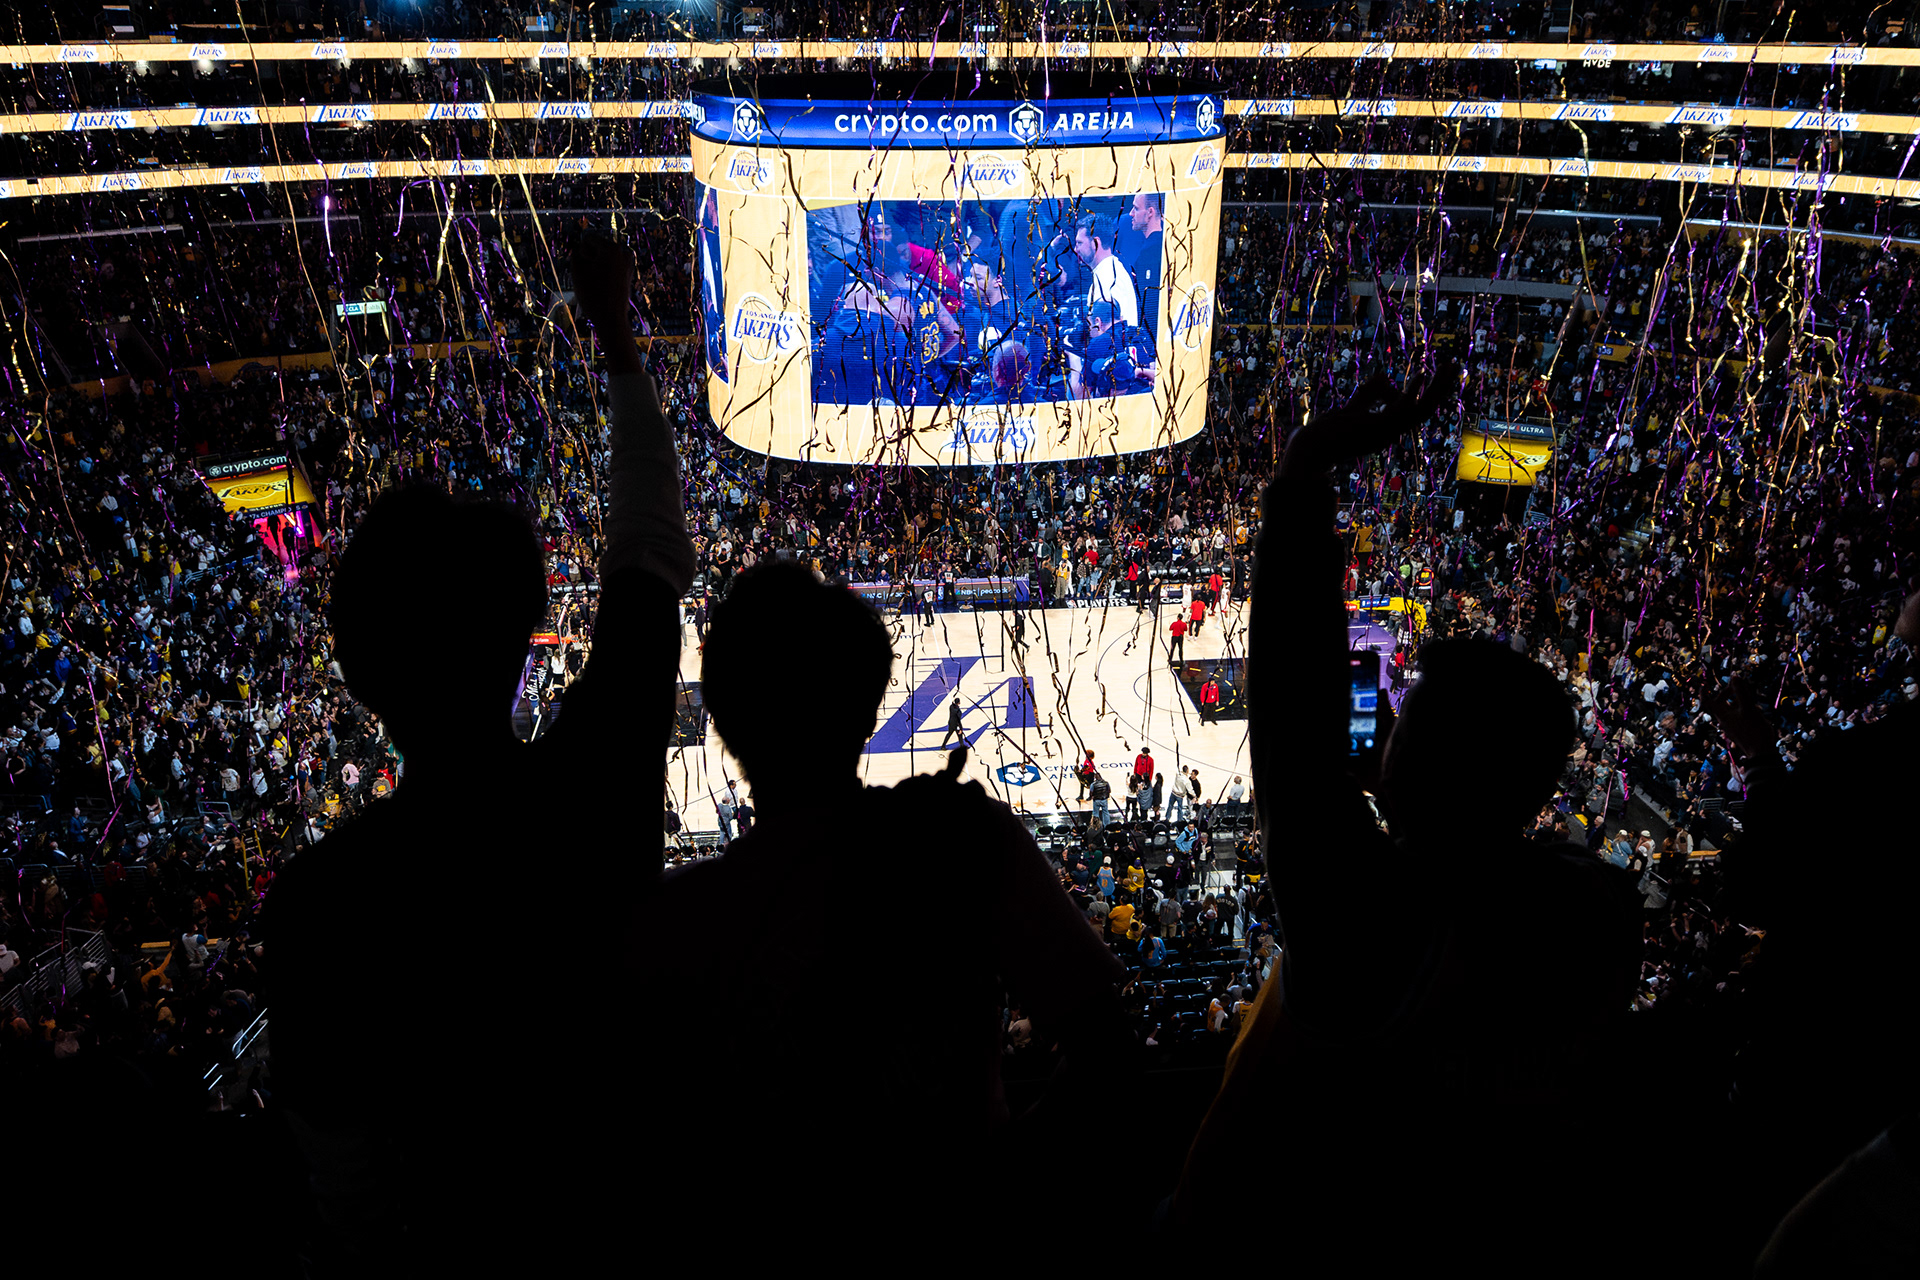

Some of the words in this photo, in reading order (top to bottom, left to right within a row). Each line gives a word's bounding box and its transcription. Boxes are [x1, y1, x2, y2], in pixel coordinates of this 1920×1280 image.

[1583, 60, 1612, 68] HYDE
[199, 108, 253, 125] LAKERS
[318, 105, 369, 122] LAKERS
[431, 103, 481, 119] LAKERS
[540, 102, 588, 118] LAKERS
[1450, 101, 1499, 117] LAKERS
[1556, 103, 1610, 121] LAKERS
[1671, 107, 1727, 125] LAKERS
[72, 112, 130, 132] LAKERS
[834, 112, 998, 137] crypto.com
[1053, 111, 1135, 131] ARENA
[962, 163, 1017, 186] LAKERS
[733, 308, 793, 350] LAKERS
[1078, 598, 1128, 609] PLAYOFFS
